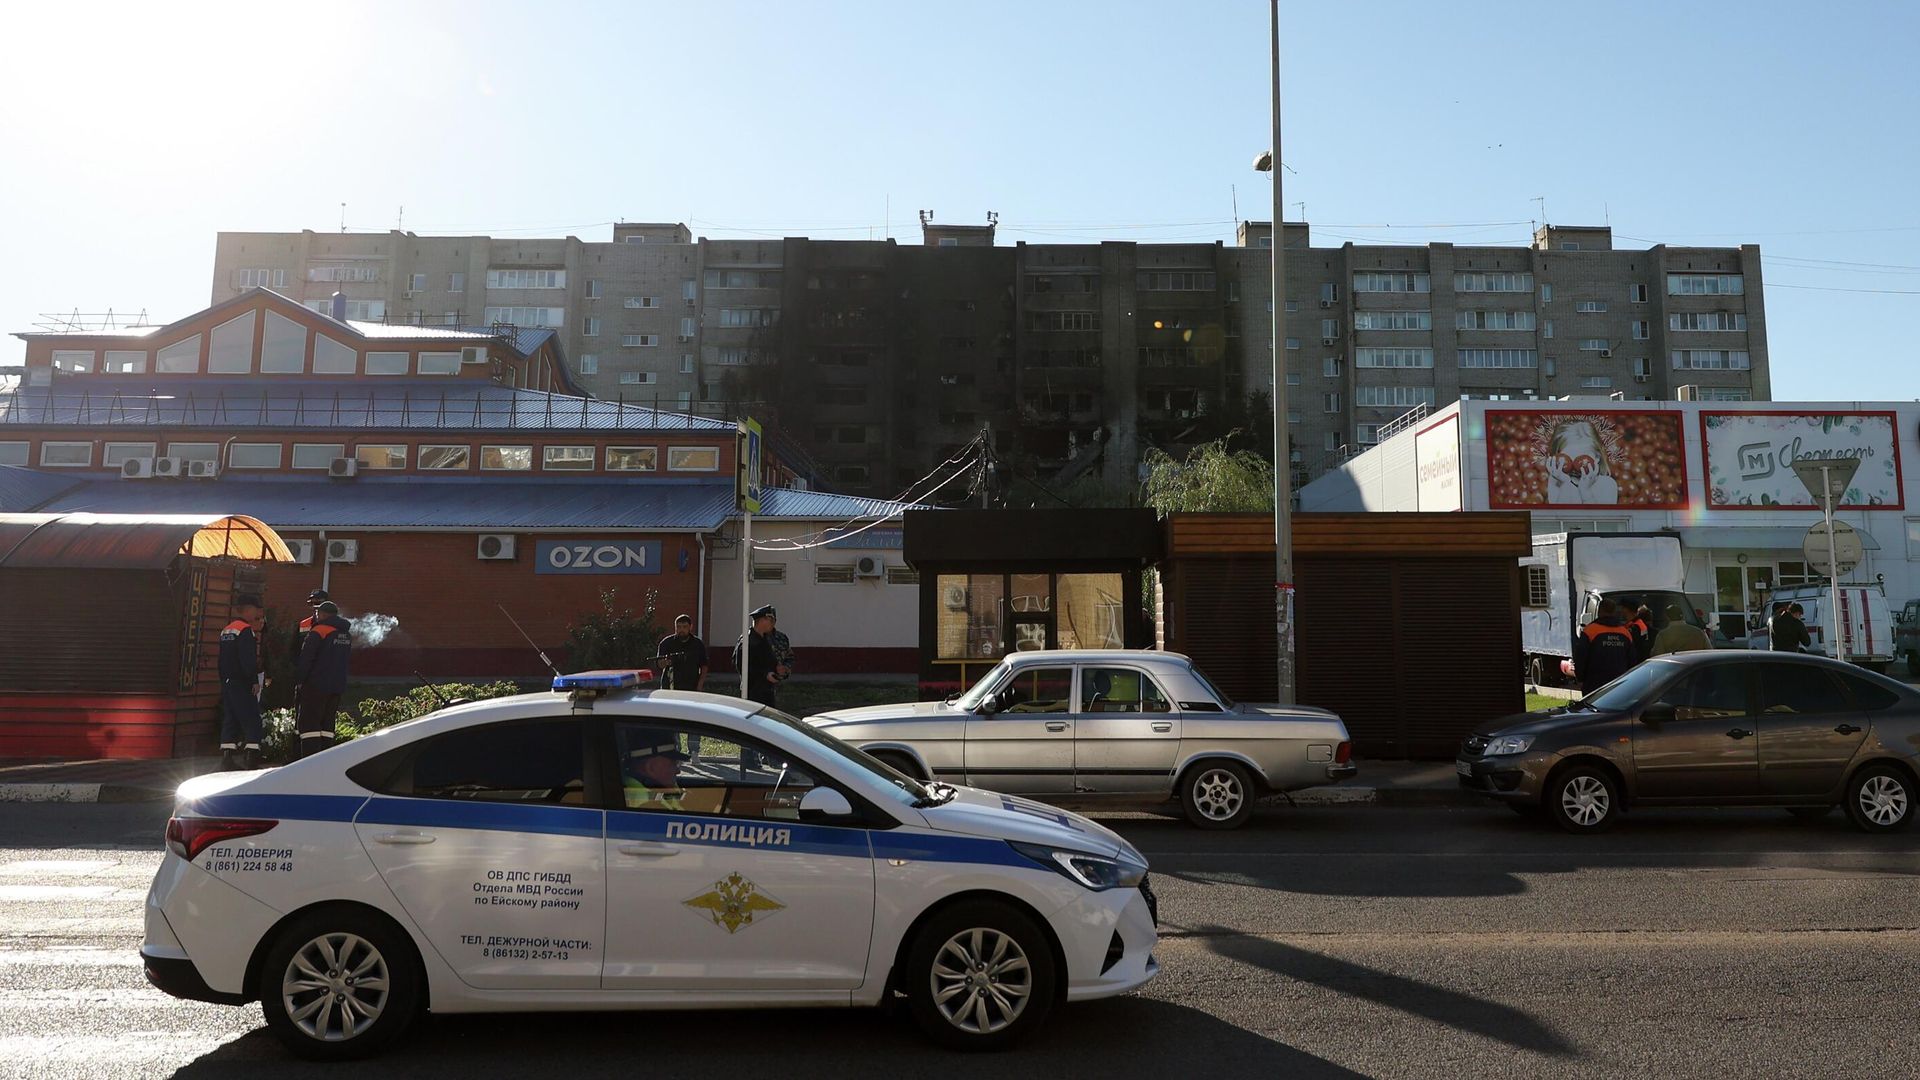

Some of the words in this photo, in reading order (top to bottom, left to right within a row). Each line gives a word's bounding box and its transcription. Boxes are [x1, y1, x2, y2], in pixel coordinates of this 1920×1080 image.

[549, 545, 646, 568] OZON
[183, 572, 202, 687] ЦВЕТЫ
[666, 821, 791, 847] ПОЛИЦИЯ
[210, 848, 234, 858] ТЕЛ.
[236, 848, 293, 860] ДОВЕРИЯ
[205, 861, 212, 871] 8
[214, 861, 240, 873] (861)
[243, 861, 261, 871] 224
[264, 862, 277, 872] 58
[280, 862, 293, 872] 48
[487, 870, 504, 880] ОВ
[506, 871, 531, 881] ДПС
[533, 872, 572, 884] ГИБДД
[473, 882, 513, 893] Отдела
[516, 884, 541, 895] МВД
[544, 886, 584, 896] России
[474, 896, 488, 905] по
[491, 896, 538, 909] Ейскому
[541, 898, 580, 910] району
[460, 935, 485, 945] ТЕЛ.
[487, 936, 550, 948] ДЕЖУРНОЙ
[552, 939, 592, 950] ЧАСТИ:
[483, 948, 489, 957] 8
[492, 948, 529, 960] (86132)
[531, 950, 569, 961] 2-57-13
